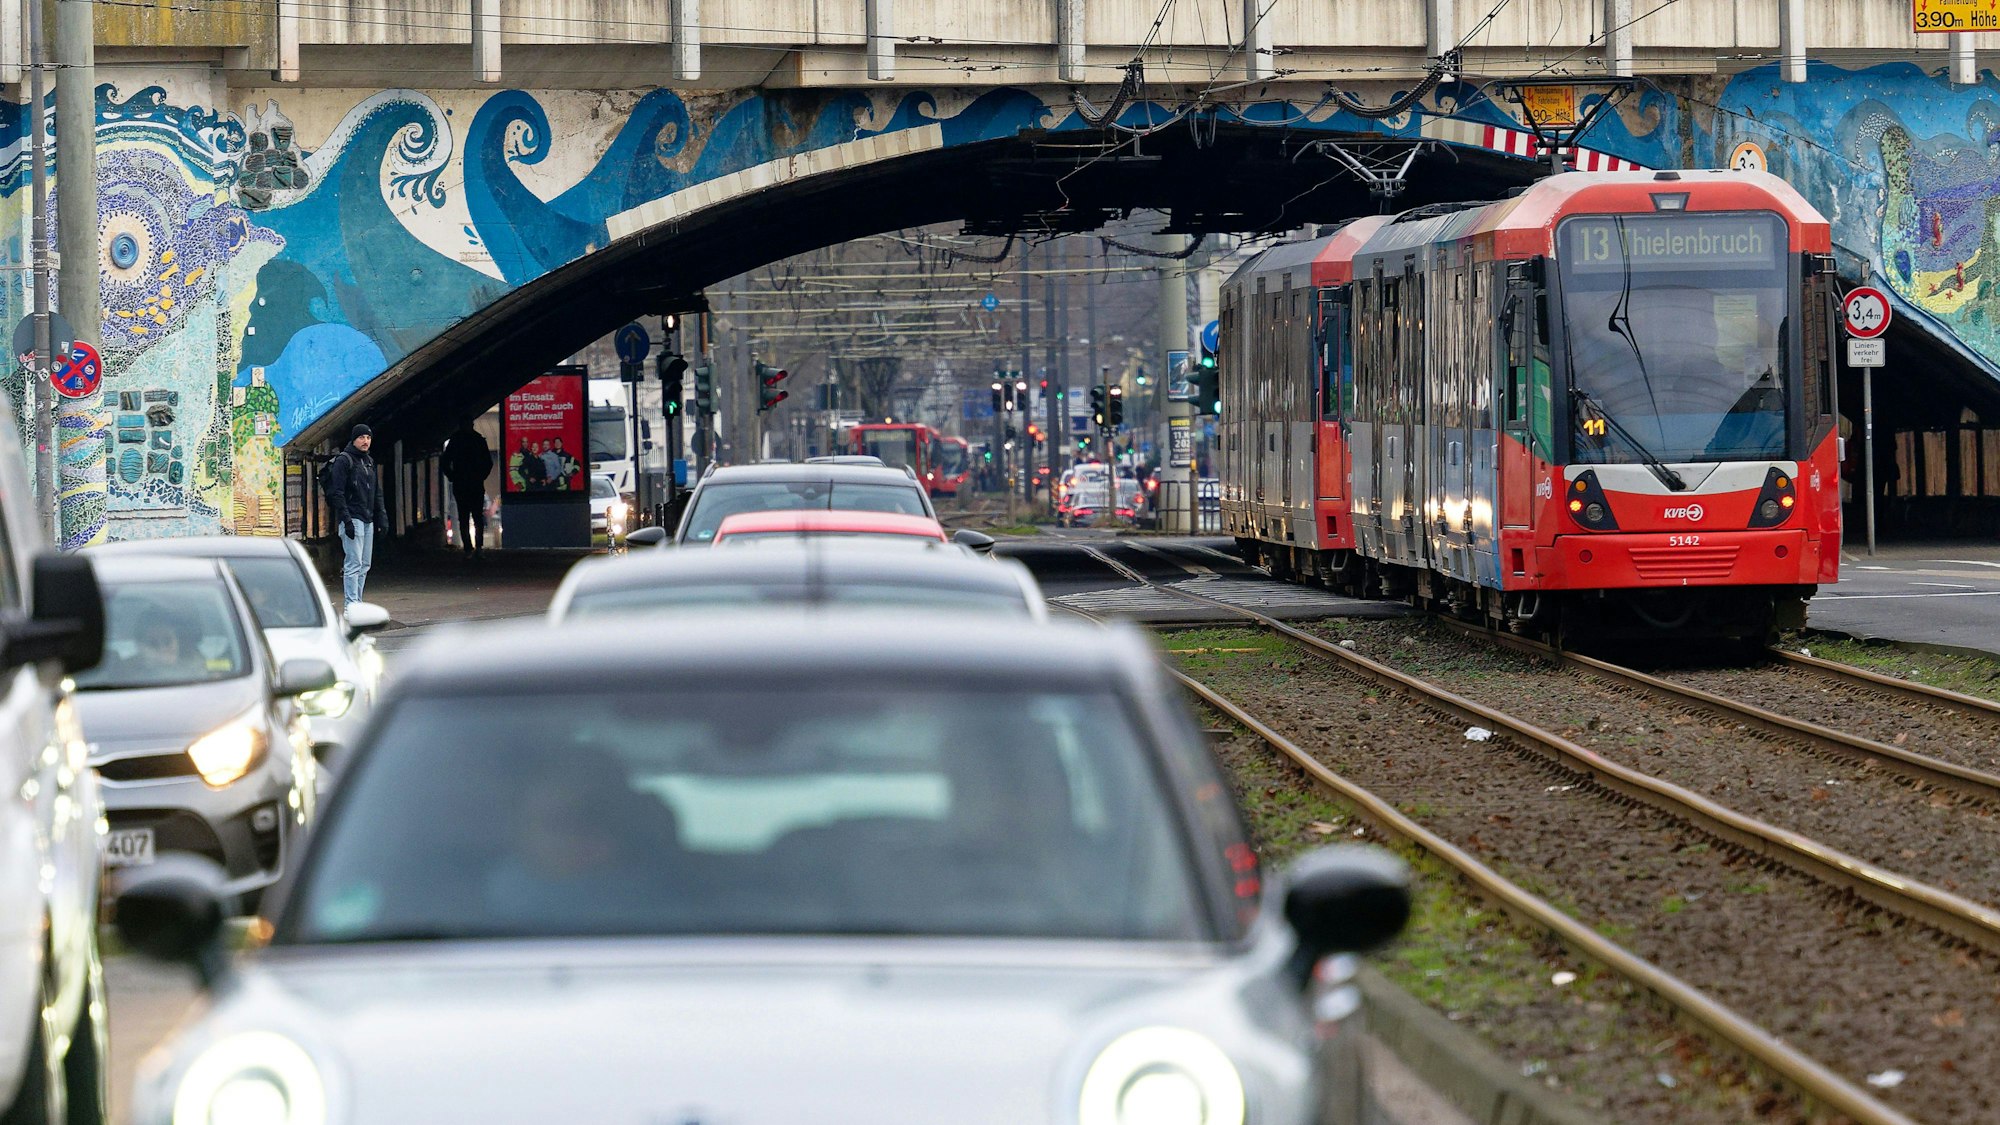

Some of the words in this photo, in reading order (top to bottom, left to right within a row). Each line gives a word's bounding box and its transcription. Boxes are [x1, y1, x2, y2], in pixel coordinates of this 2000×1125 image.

[1971, 10, 1997, 27] Höhe
[1581, 227, 1608, 261] 13
[1620, 226, 1762, 256] Thielenbruch
[522, 393, 554, 401] Einsatz
[509, 403, 522, 411] für
[524, 402, 543, 410] Köln
[551, 402, 573, 410] auch
[509, 413, 521, 421] an
[522, 411, 564, 420] Karneval!
[1583, 419, 1605, 436] 11
[1664, 508, 1687, 519] KVB
[1669, 535, 1700, 547] 5142
